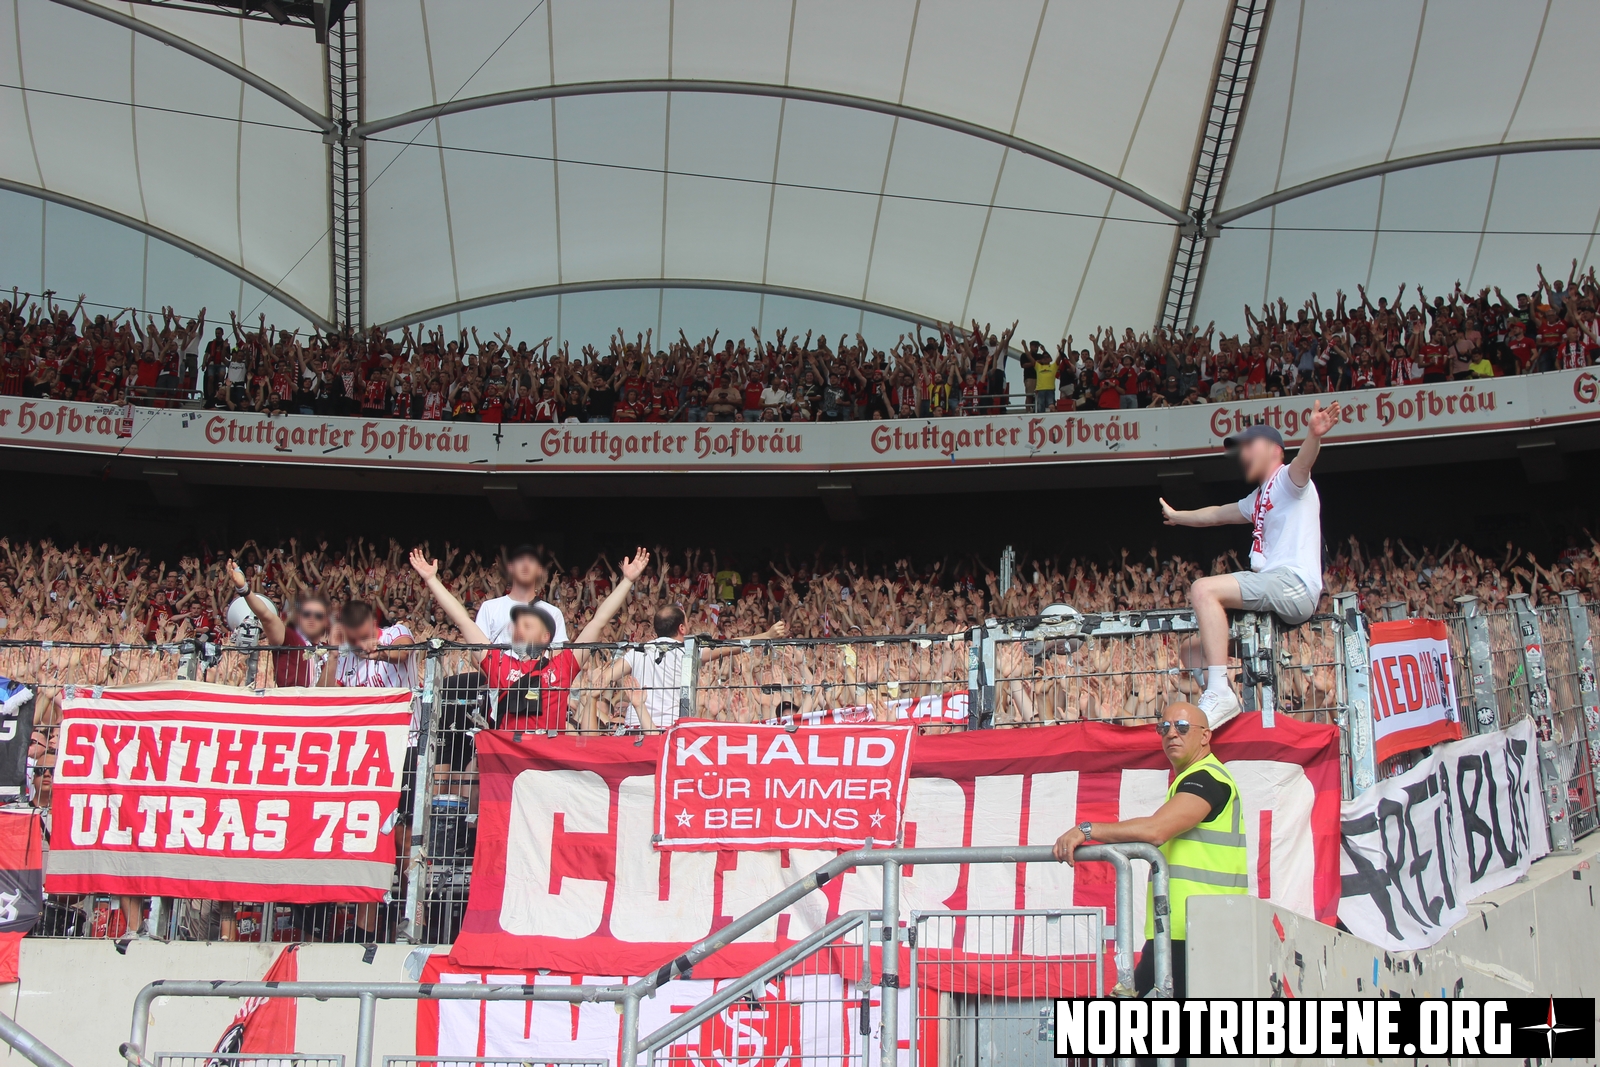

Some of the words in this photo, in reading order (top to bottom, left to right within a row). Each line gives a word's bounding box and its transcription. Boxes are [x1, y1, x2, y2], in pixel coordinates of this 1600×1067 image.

[1210, 402, 1370, 438] Stuttger
[1375, 386, 1497, 426] Hofbräu
[205, 415, 356, 449] Stuttgarter
[360, 421, 470, 454] Hofbräu
[540, 427, 688, 461] Stuttgarter
[694, 426, 803, 459] Hofbräu
[871, 424, 1021, 456] Stuttgarter
[1027, 415, 1141, 449] Hofbräu
[62, 723, 395, 787] SYNTHESIA
[676, 734, 896, 766] KHALID
[673, 772, 751, 800] FÜR
[765, 778, 892, 800] IMMER
[69, 794, 289, 851] ULTRAS
[312, 801, 381, 853] 79
[704, 808, 761, 829] BEI
[775, 808, 859, 830] UNS
